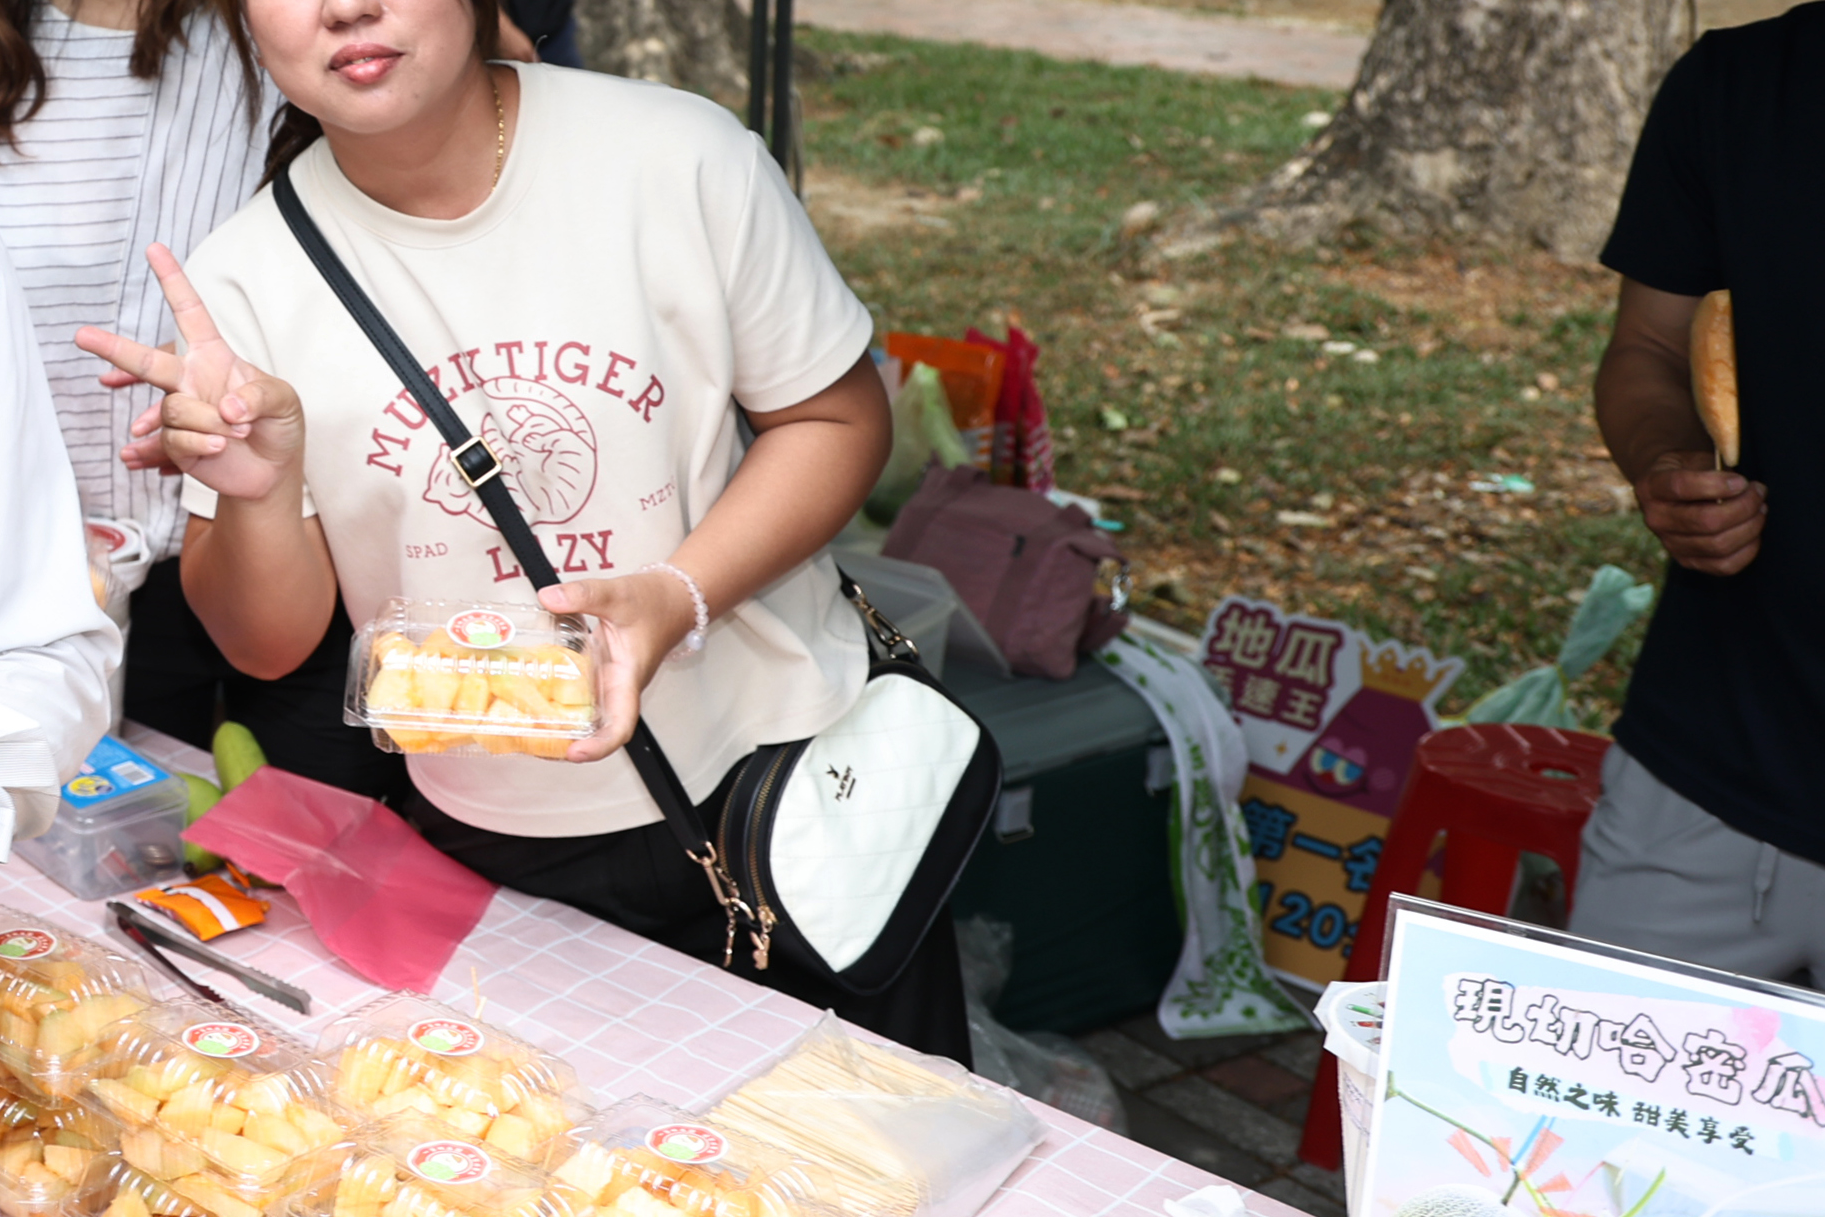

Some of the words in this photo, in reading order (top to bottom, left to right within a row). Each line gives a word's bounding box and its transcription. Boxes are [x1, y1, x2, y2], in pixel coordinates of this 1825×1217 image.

[495, 340, 666, 424] TIGER
[485, 529, 615, 584] LZY
[1213, 607, 1339, 688] 地瓜
[1454, 978, 1825, 1128] 現切哈密瓜
[1507, 1066, 1622, 1118] 自然之味
[1631, 1101, 1756, 1156] 甜美享受
